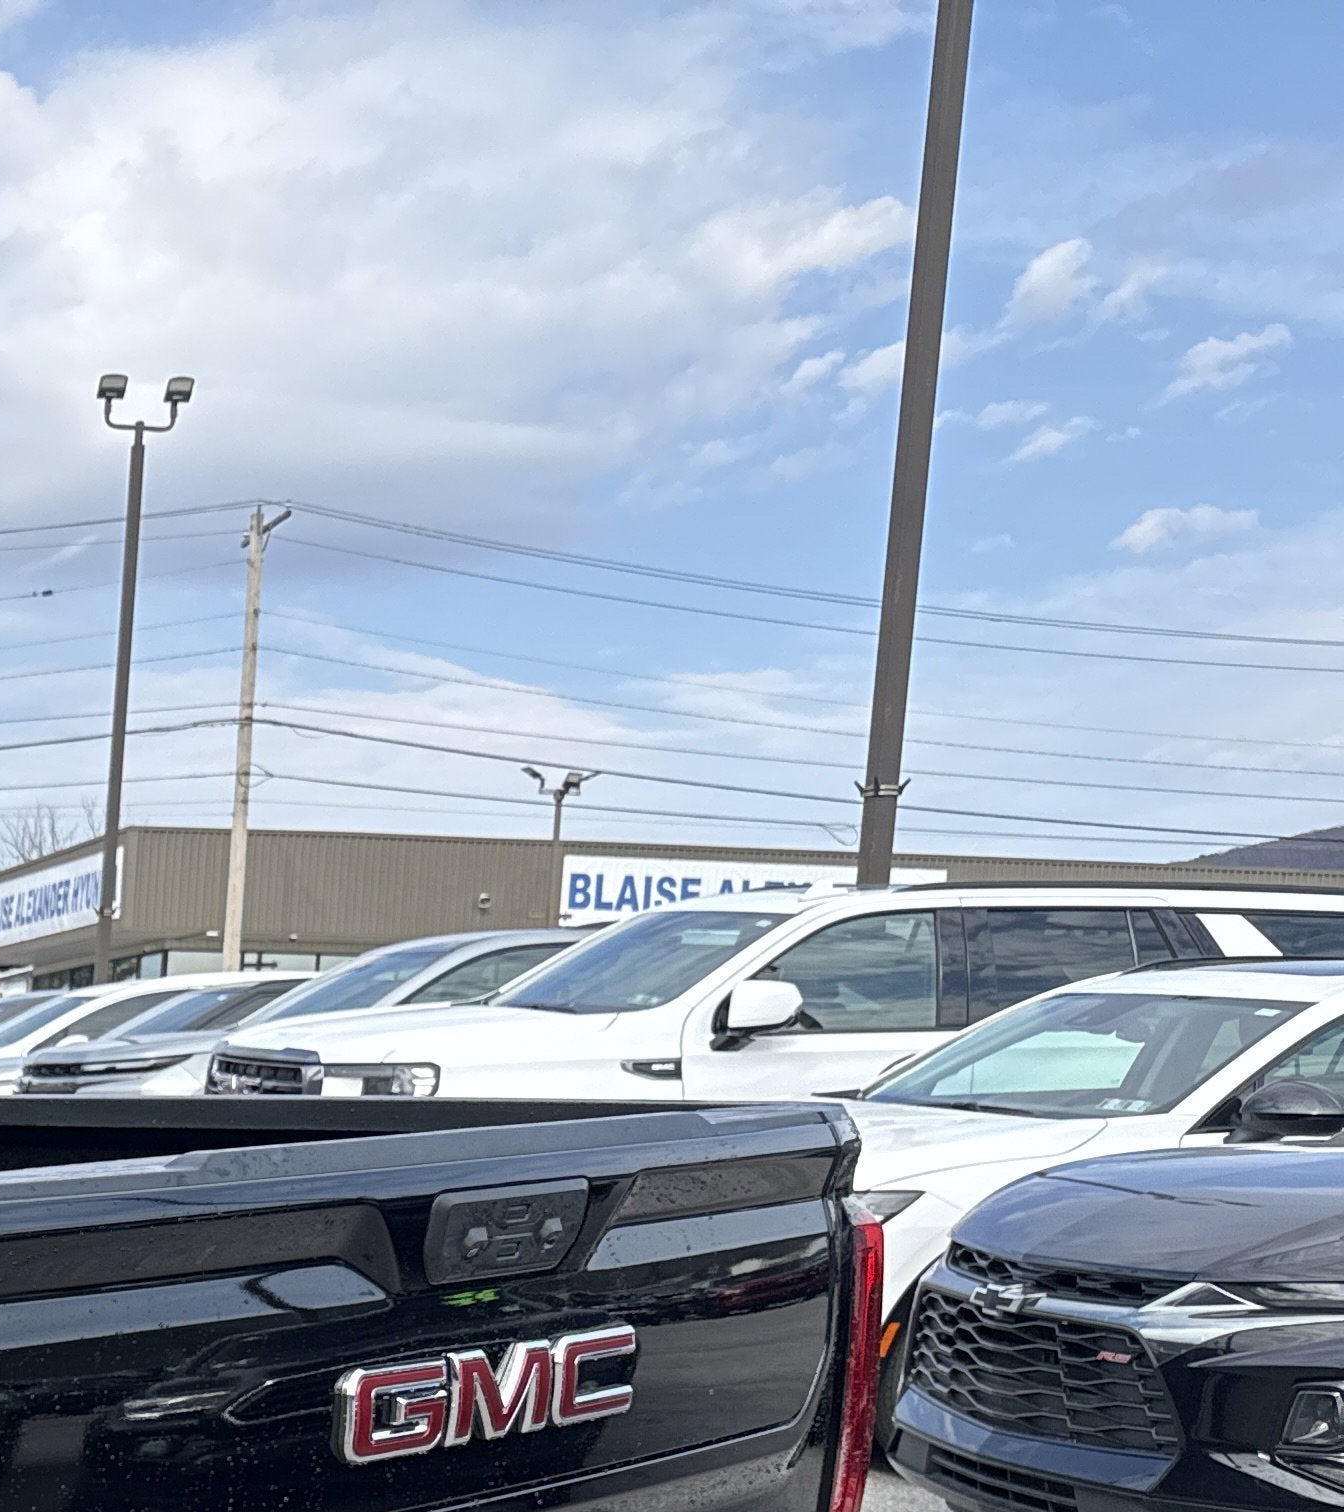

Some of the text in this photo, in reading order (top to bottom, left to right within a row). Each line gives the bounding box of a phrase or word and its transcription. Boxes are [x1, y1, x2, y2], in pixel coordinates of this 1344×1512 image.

[15, 879, 71, 927] ALEXANDER
[71, 870, 101, 912] HYUN
[568, 873, 702, 912] BLAISE
[334, 1324, 637, 1466] GMC
